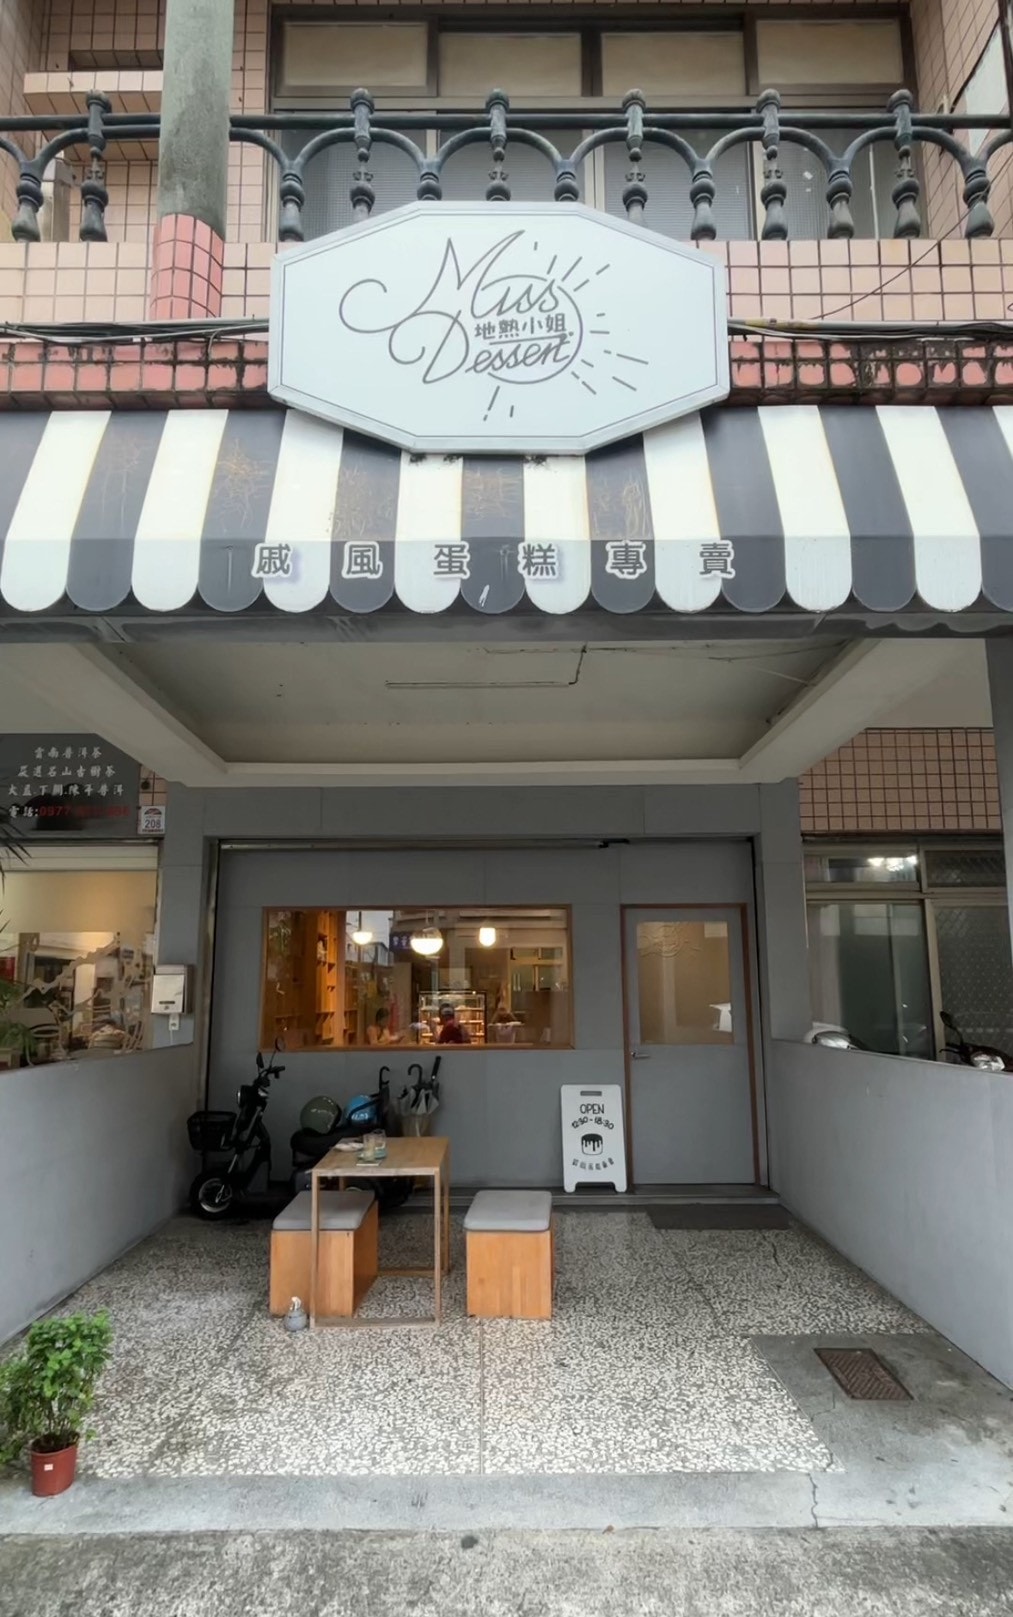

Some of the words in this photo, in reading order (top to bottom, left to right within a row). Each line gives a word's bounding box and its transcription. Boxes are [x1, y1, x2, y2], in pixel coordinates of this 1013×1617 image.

[339, 229, 559, 334] Miss
[474, 313, 567, 341] 地熱小姐
[388, 310, 575, 385] Dessert
[255, 541, 736, 578] 戚風蛋糕專賣
[144, 819, 162, 829] 208
[580, 1103, 605, 1115] OPEN
